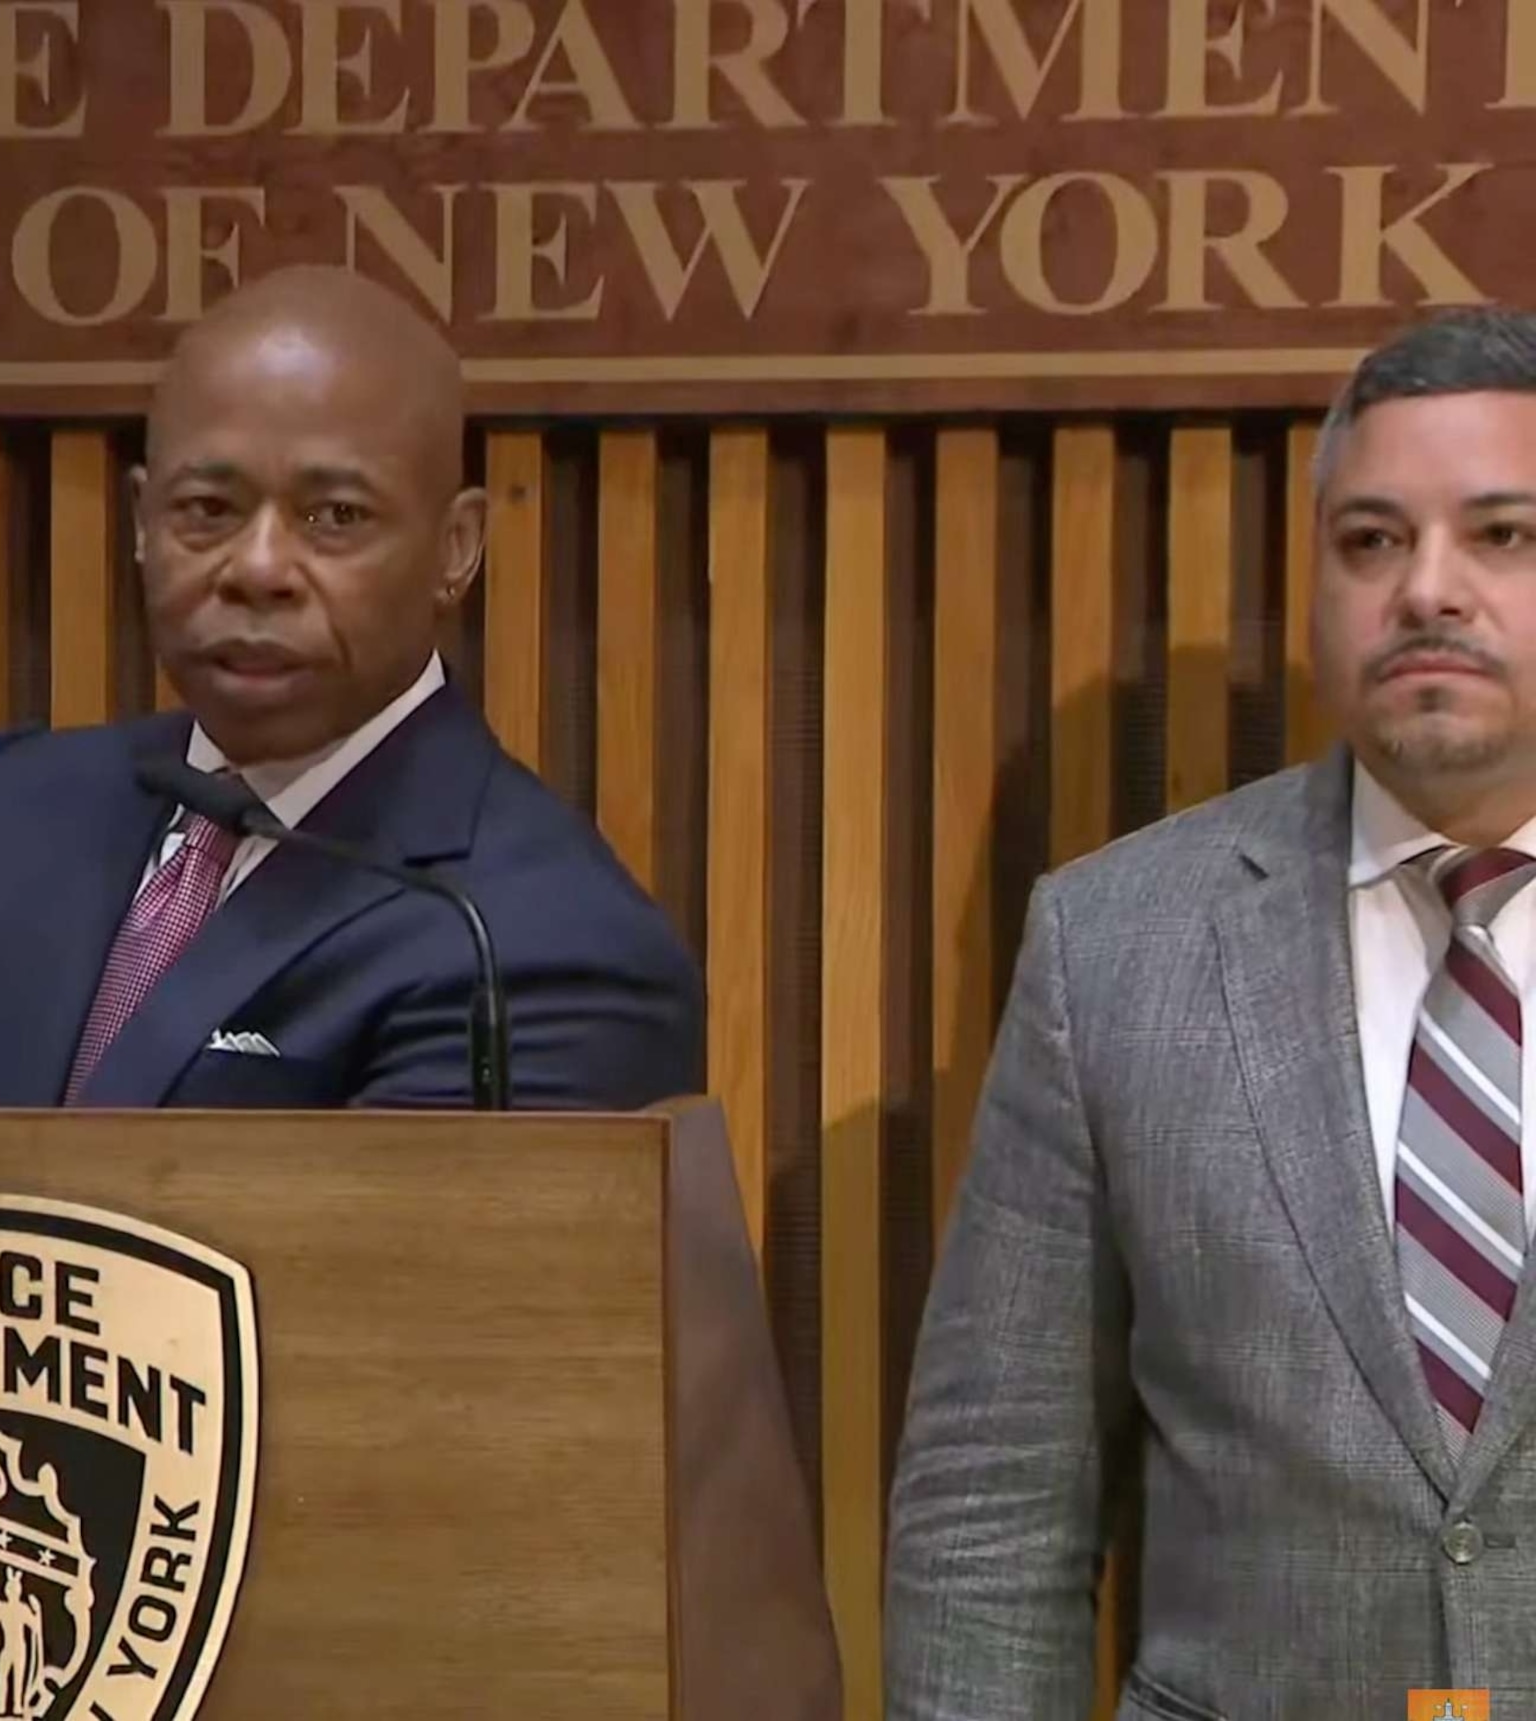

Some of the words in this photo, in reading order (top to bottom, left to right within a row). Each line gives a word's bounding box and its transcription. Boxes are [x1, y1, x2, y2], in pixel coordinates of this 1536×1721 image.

[12, 187, 265, 328] OF
[332, 178, 810, 326] NEW
[872, 162, 1499, 320] YORK
[105, 1493, 202, 1680] YORK
